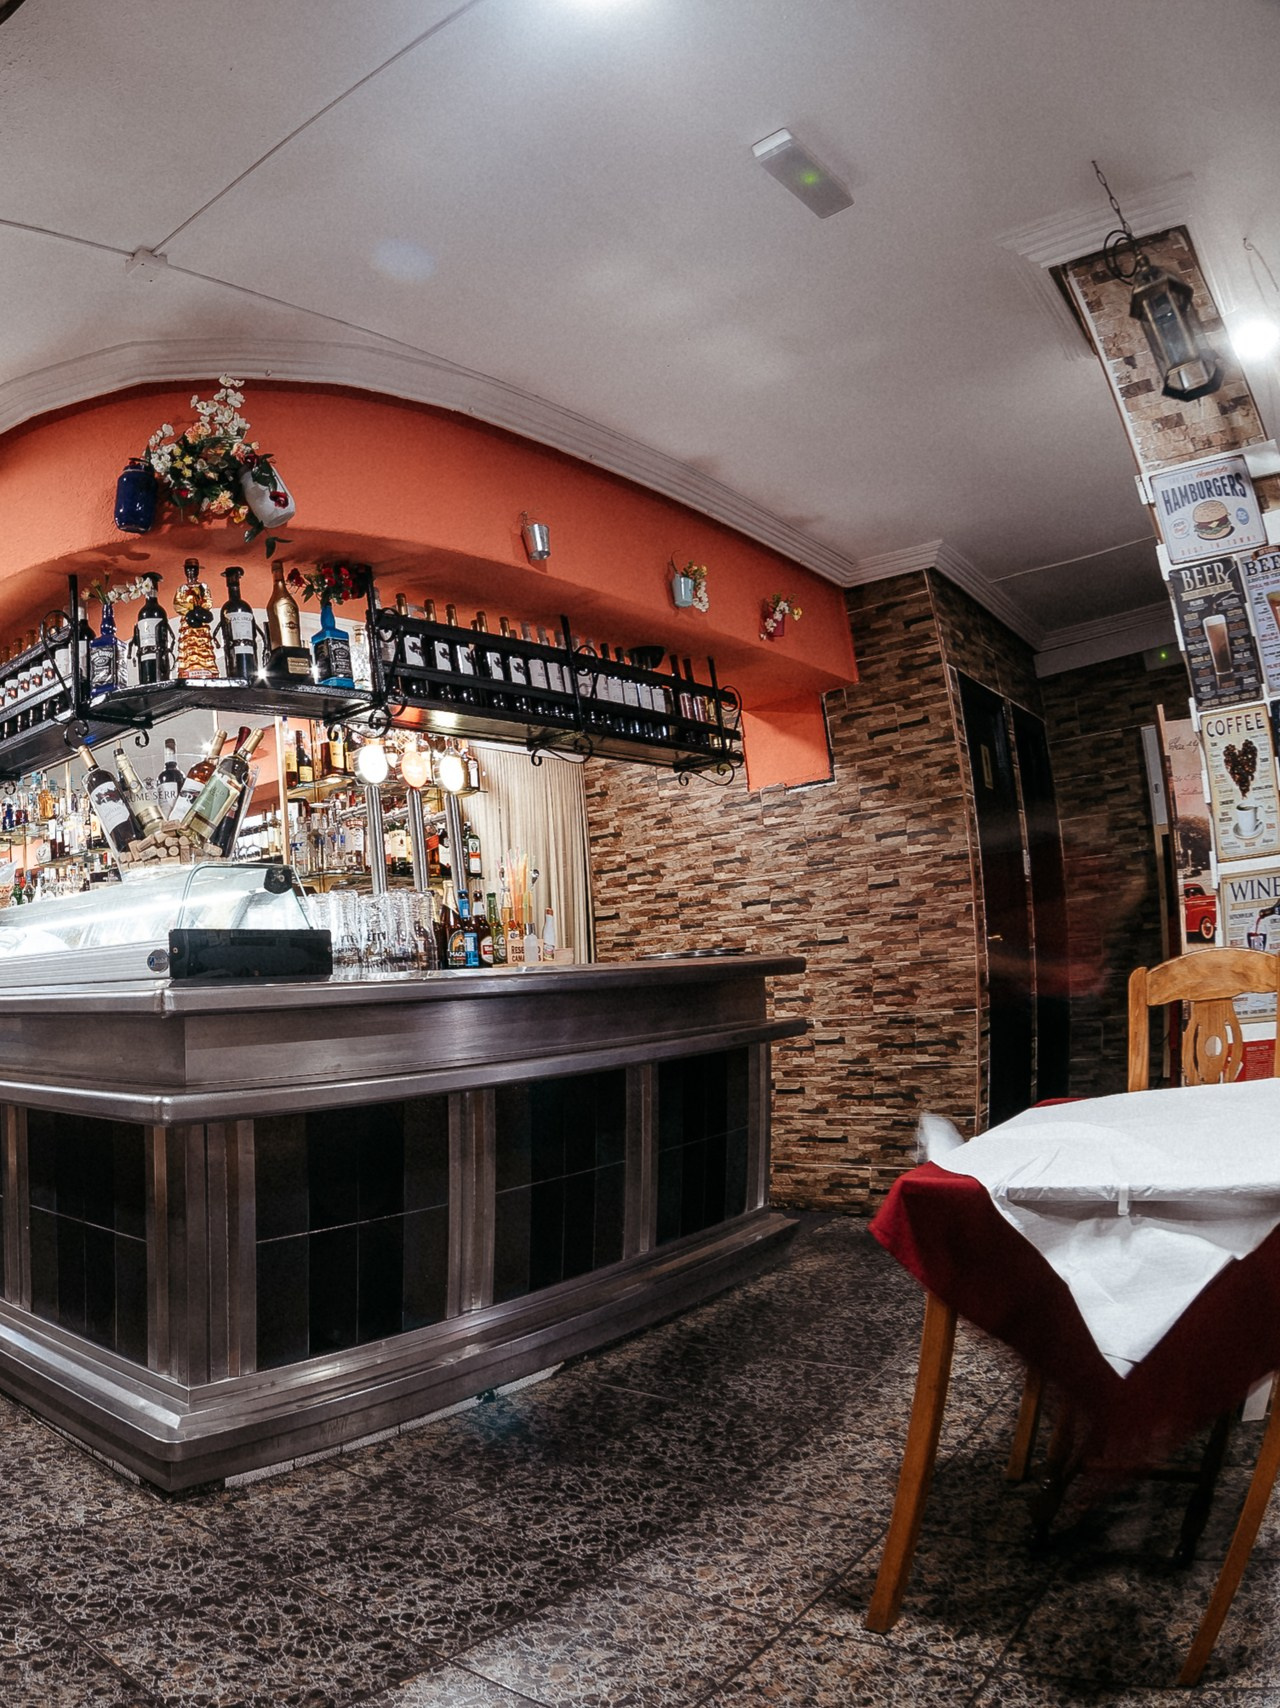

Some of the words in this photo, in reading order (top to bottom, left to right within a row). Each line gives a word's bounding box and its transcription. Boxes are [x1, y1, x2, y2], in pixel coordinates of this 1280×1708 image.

[1161, 472, 1247, 516] HAMBURGERS
[1180, 562, 1231, 592] BEER
[1206, 712, 1265, 737] COFFEE
[153, 790, 177, 801] SERR
